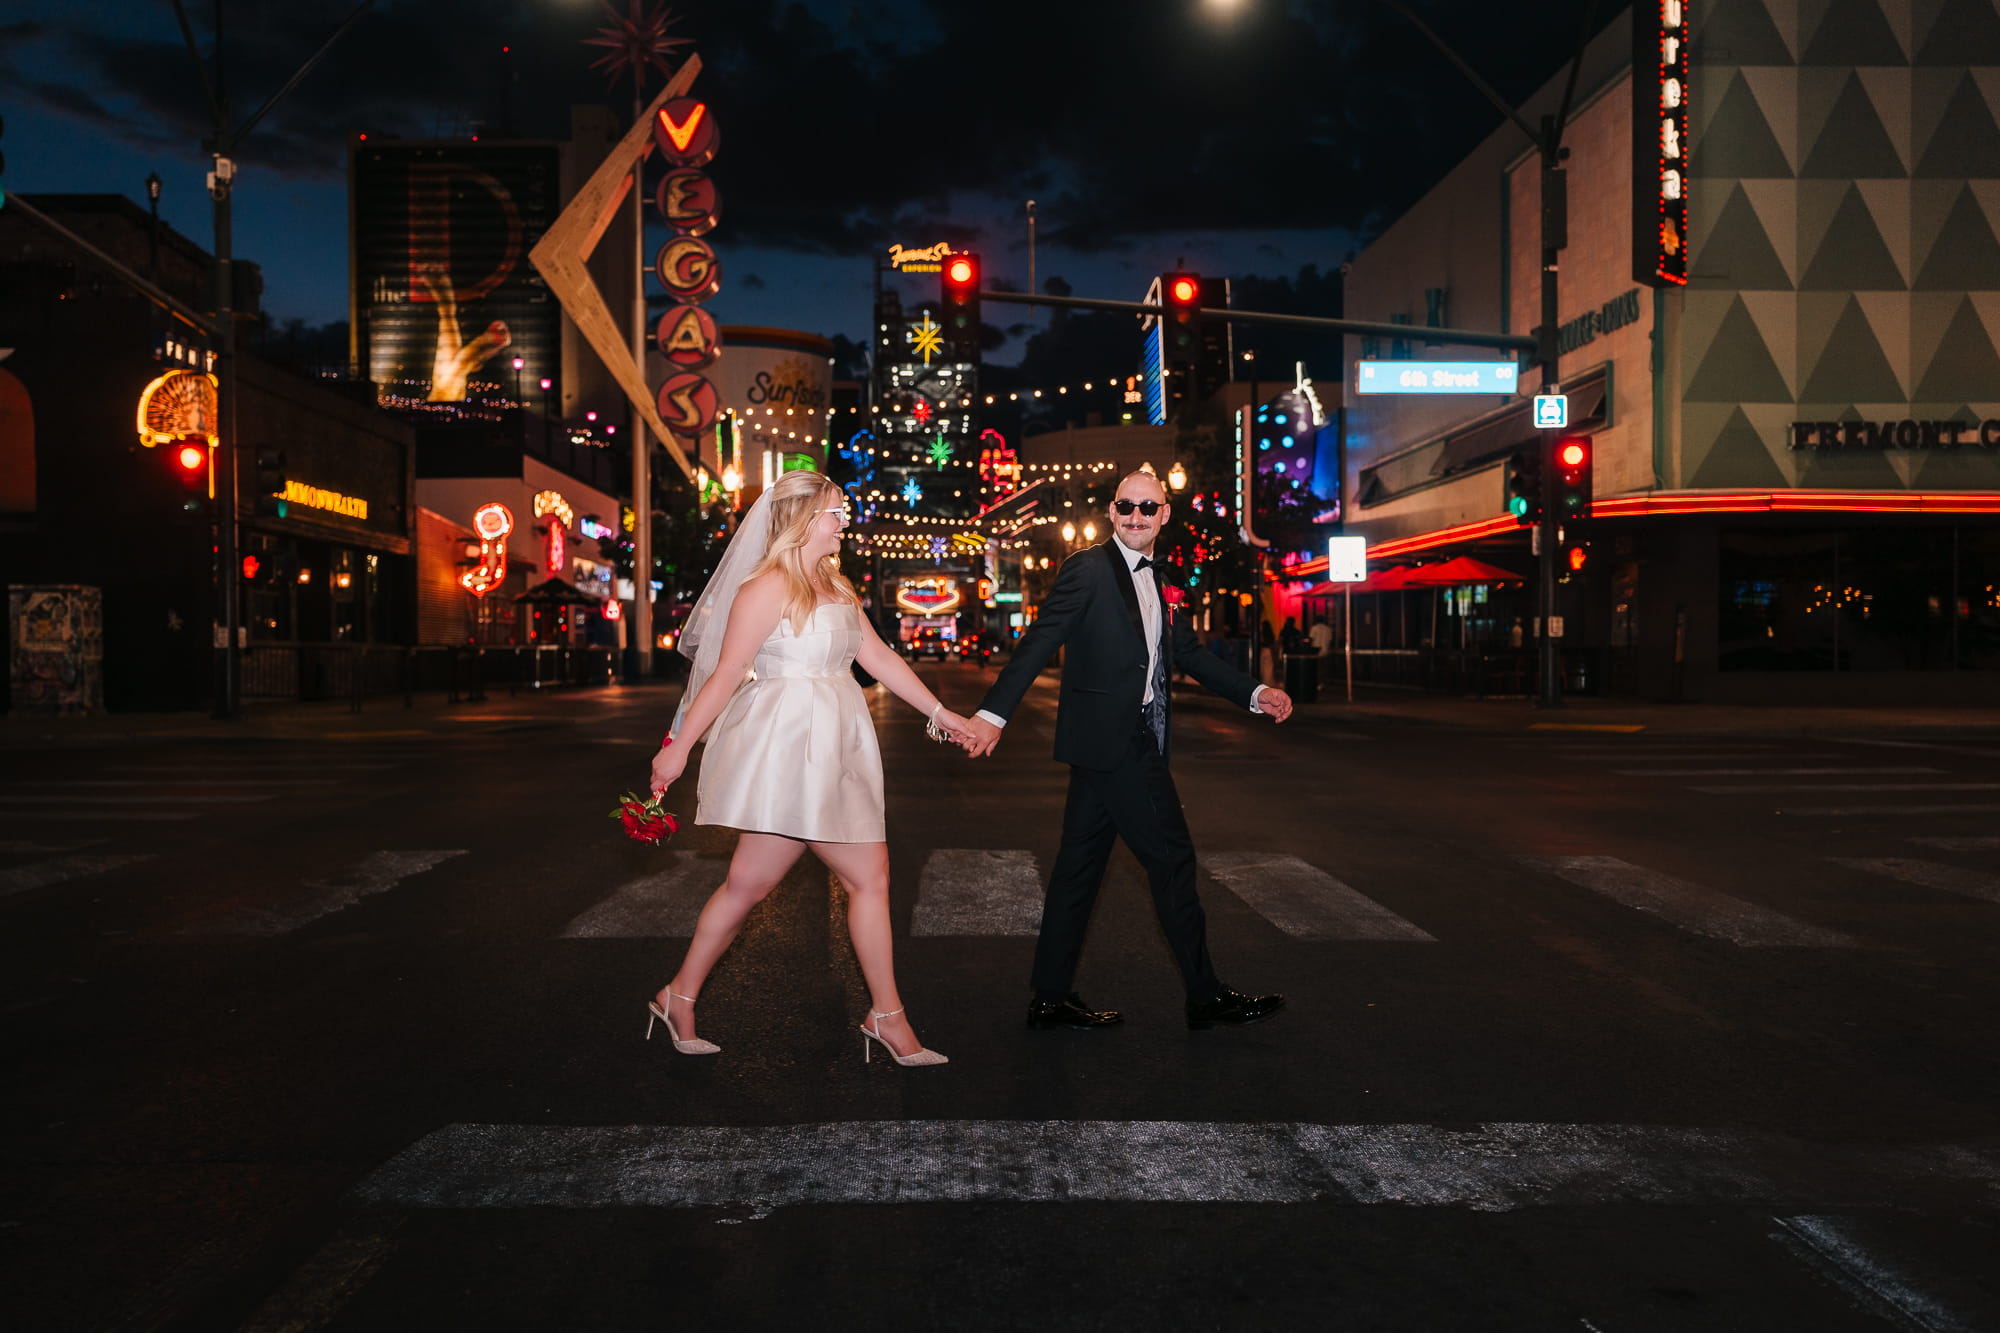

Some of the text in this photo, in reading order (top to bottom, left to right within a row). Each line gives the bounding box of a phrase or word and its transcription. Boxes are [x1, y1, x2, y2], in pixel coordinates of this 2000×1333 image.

[658, 102, 717, 430] VEGAS
[1400, 370, 1427, 387] 6th
[1432, 370, 1479, 387] Street
[1791, 419, 1966, 450] FREMONT
